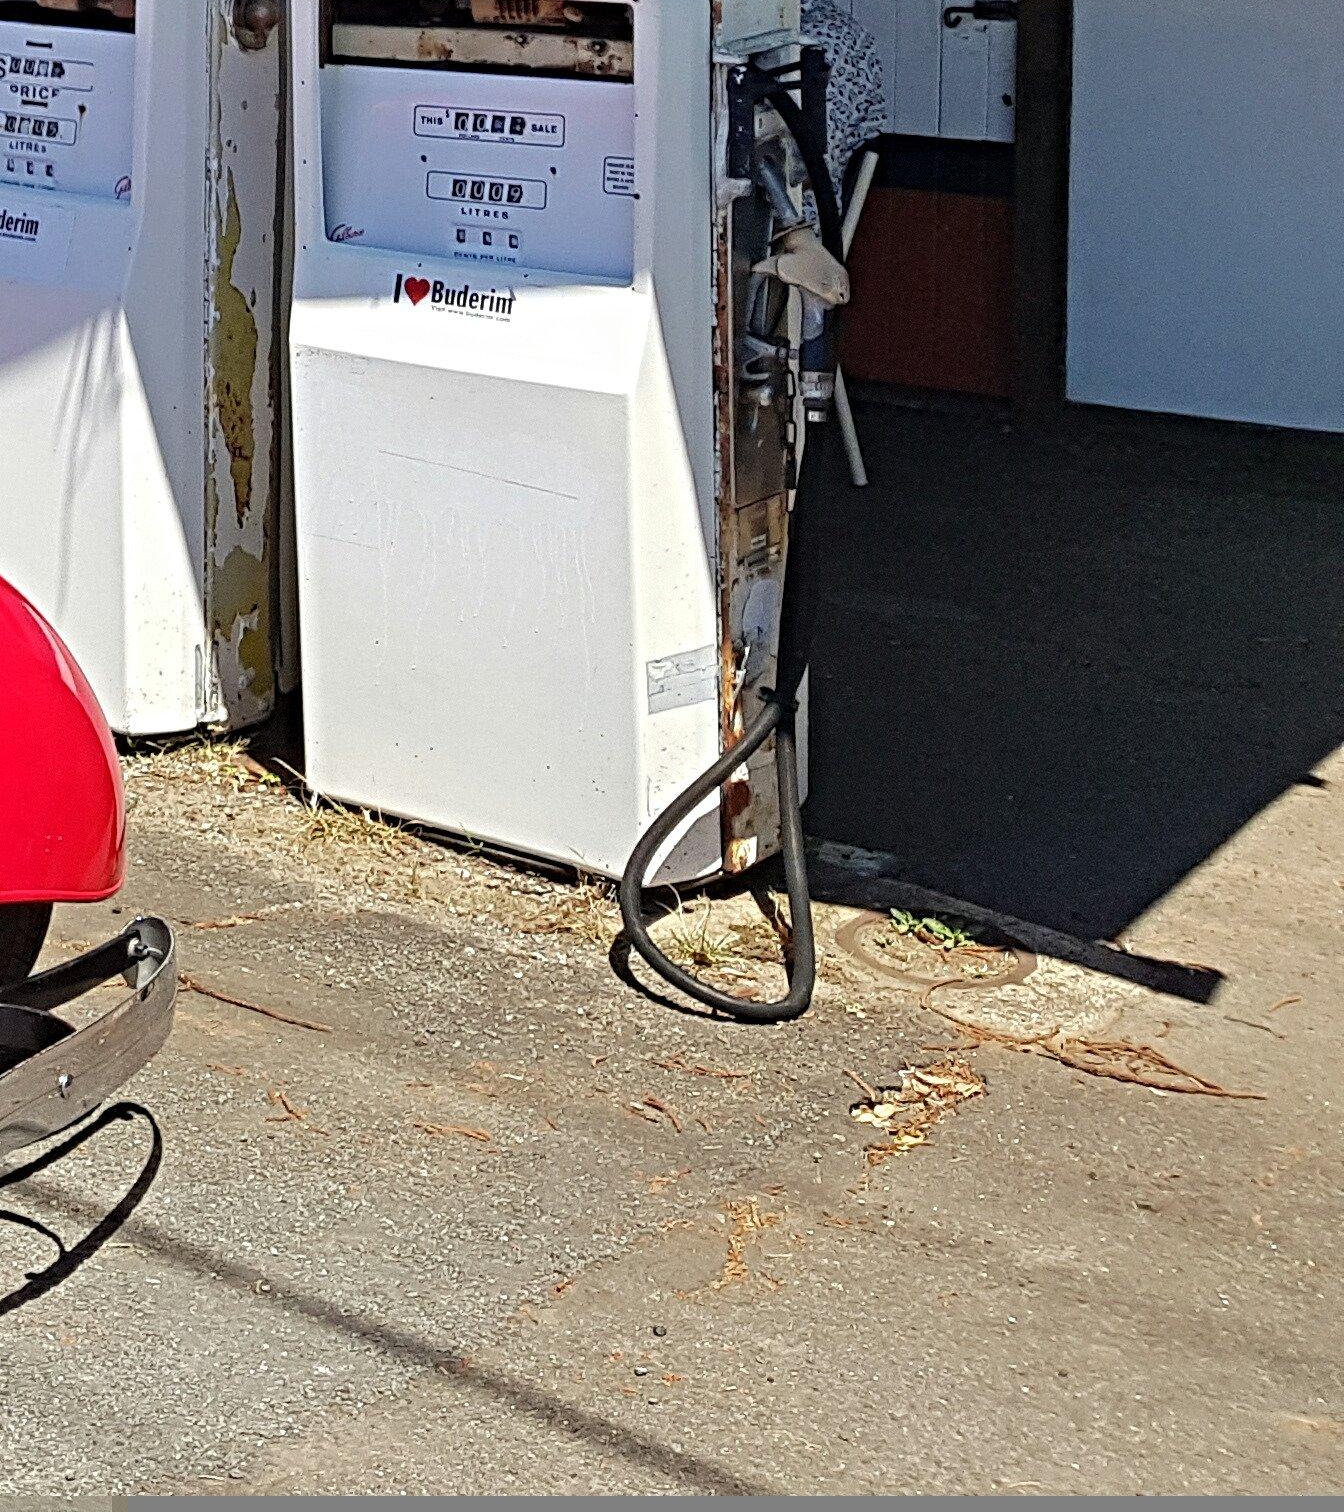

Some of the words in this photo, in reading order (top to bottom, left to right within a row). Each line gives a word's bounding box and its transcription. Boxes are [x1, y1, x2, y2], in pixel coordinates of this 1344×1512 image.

[420, 115, 444, 126] THIS
[530, 123, 558, 134] SALE
[461, 207, 510, 220] LITRES
[430, 280, 513, 315] Buderim
